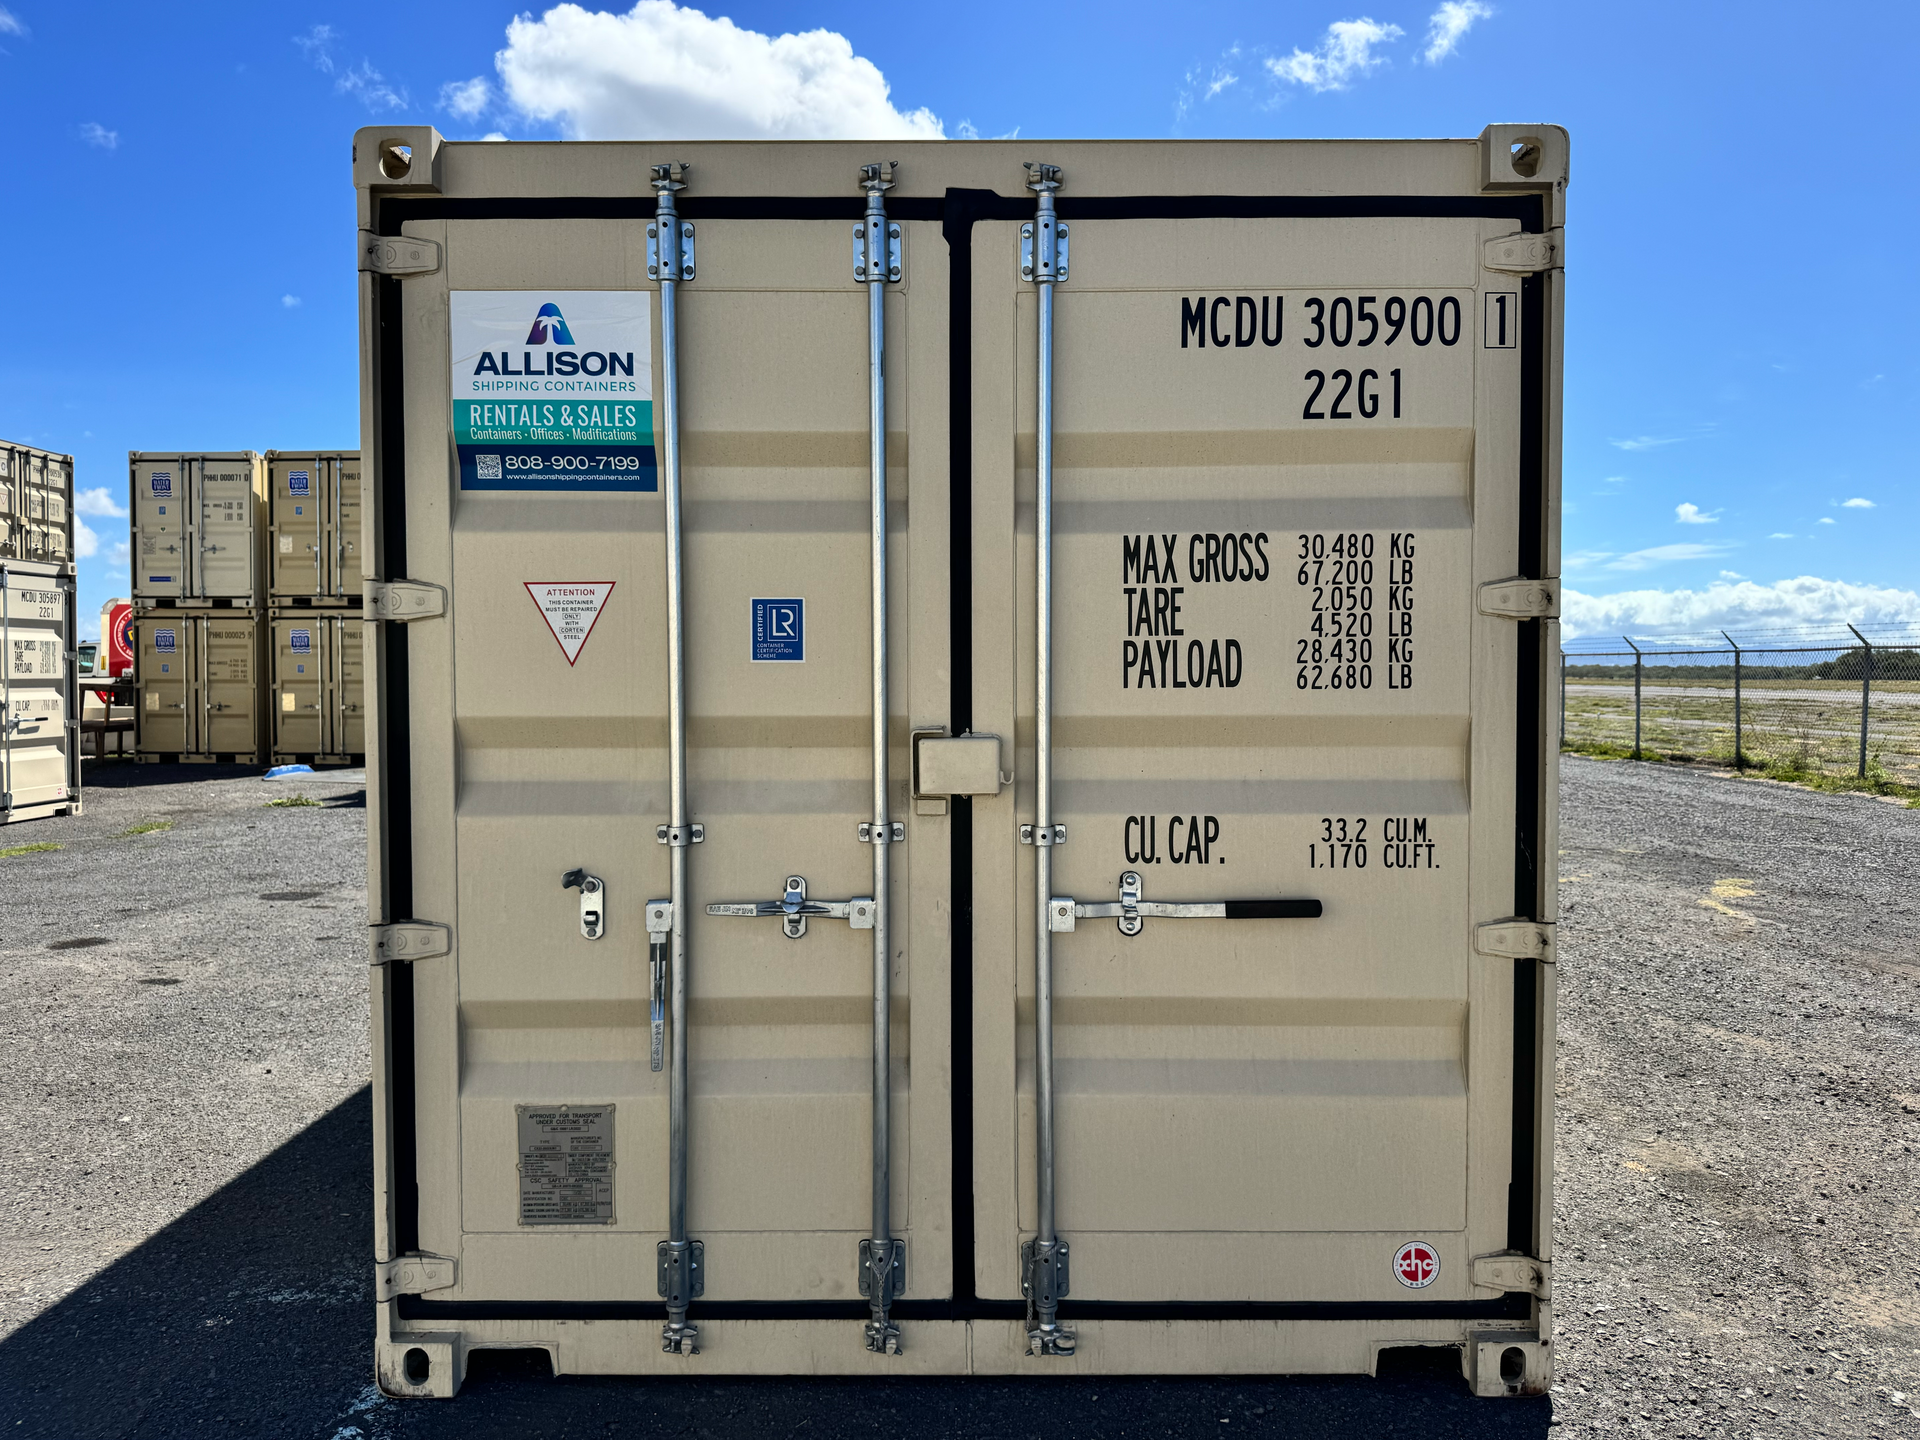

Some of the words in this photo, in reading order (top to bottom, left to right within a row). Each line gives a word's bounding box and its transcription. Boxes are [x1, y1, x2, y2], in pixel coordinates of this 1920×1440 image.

[1180, 295, 1284, 349] MCDU
[1302, 296, 1462, 348] 305900
[473, 351, 634, 376] ALLISON
[472, 380, 540, 392] SHIPPING
[544, 380, 636, 392] CONTAINERS
[1302, 368, 1402, 420] 22G1
[470, 404, 554, 426] RENTALS
[560, 405, 574, 426] &
[578, 405, 636, 427] SALES
[470, 427, 522, 440] Containers
[530, 428, 565, 440] Offices
[572, 428, 637, 441] Modifications
[505, 456, 640, 470] 808-900-7199
[220, 474, 241, 482] 000071
[506, 473, 640, 482] www.allisonshippingcontainers.com
[1122, 534, 1178, 584] MAX
[1188, 532, 1270, 583] GROSS
[1298, 532, 1374, 560] 30,480
[1390, 532, 1416, 559] KG
[1297, 559, 1374, 586] 67,200
[1389, 559, 1414, 586] LB
[21, 591, 37, 603] MCDU
[39, 592, 60, 604] 305897
[1311, 586, 1373, 612] 2,050
[1388, 585, 1414, 612] KG
[39, 607, 53, 618] 22G1
[772, 609, 795, 636] LR
[1122, 586, 1184, 637] TARE
[1310, 612, 1372, 639] 4,520
[1388, 612, 1412, 638] LB
[1122, 638, 1242, 689] PAYLOAD
[1296, 638, 1372, 665] 28,430
[1388, 638, 1414, 664] KG
[1296, 664, 1372, 690] 62,680
[1388, 664, 1412, 690] LB
[1124, 815, 1162, 864] CU.
[1168, 815, 1226, 864] CAP.
[1321, 818, 1368, 844] 33.2
[1383, 818, 1433, 844] CU.M.
[1309, 844, 1367, 870] 1,170
[1383, 844, 1440, 869] CU.FT.
